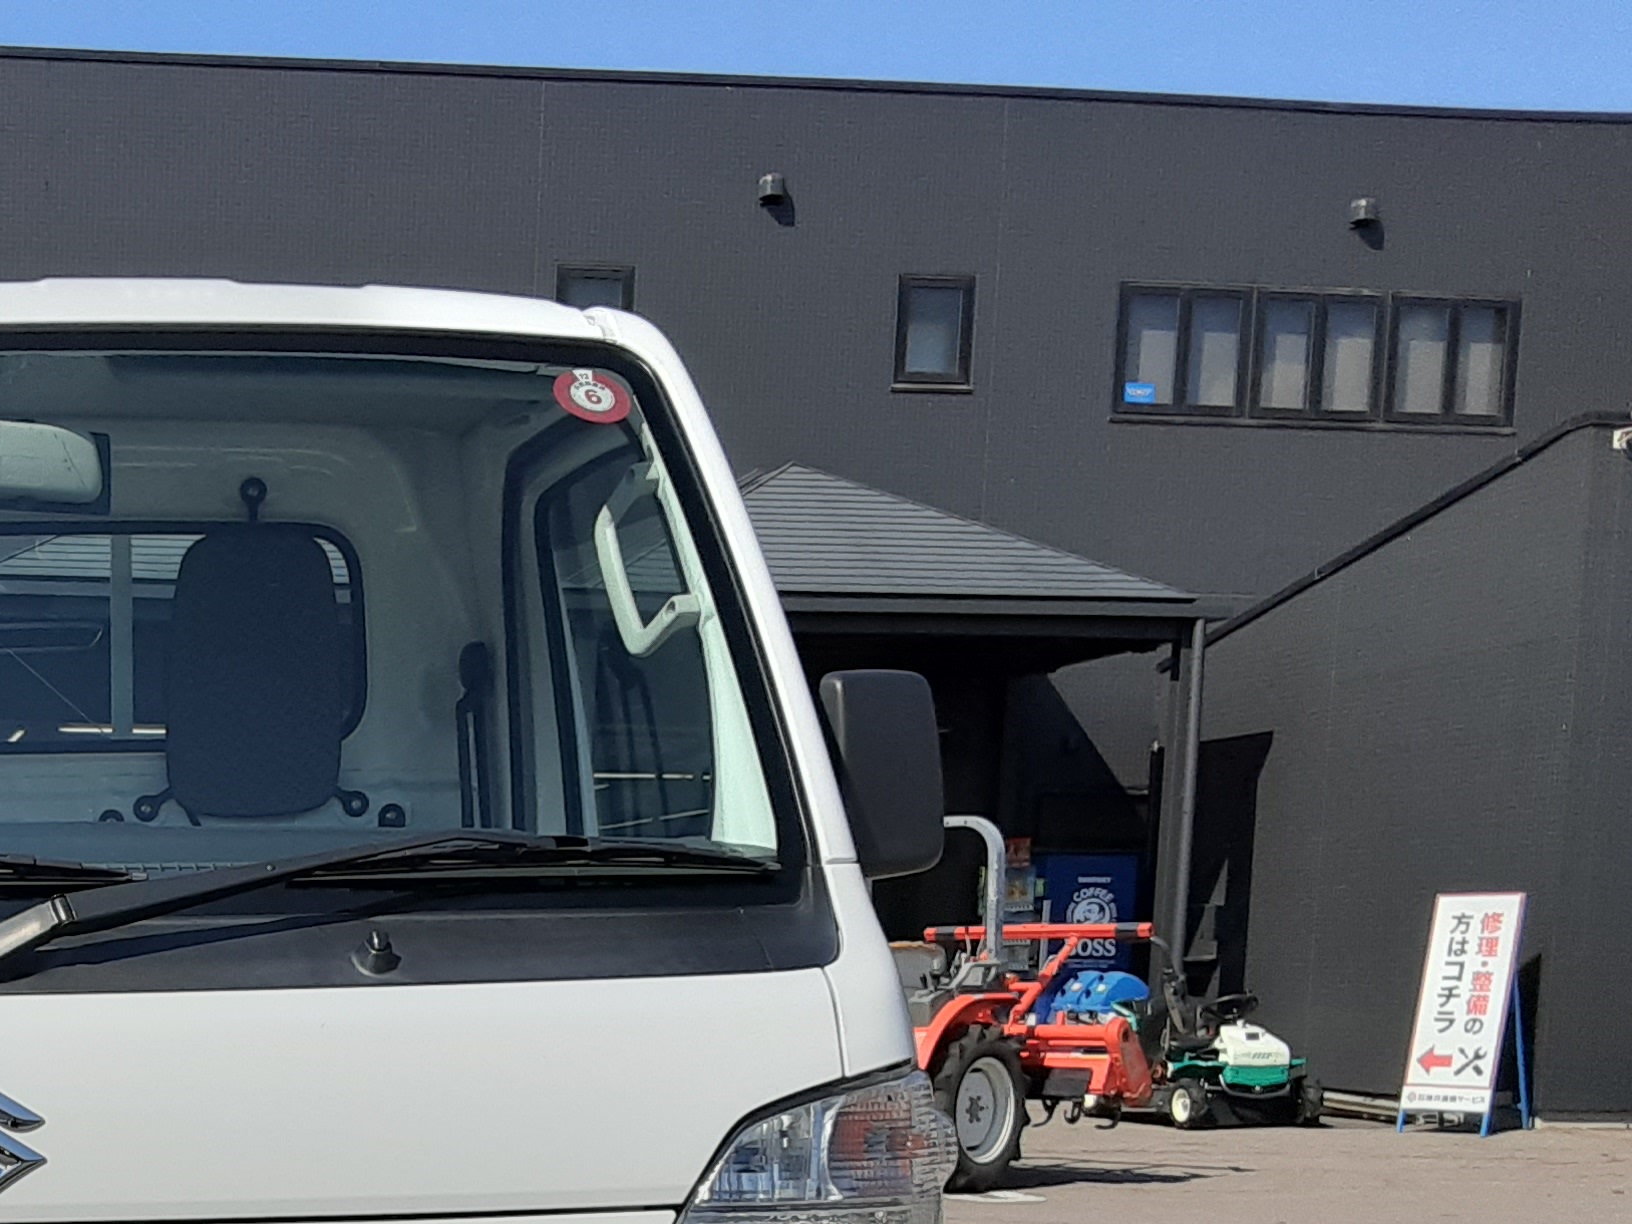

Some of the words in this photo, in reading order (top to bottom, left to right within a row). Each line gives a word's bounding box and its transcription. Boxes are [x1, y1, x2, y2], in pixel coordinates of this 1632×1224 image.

[584, 389, 603, 405] 6
[1433, 912, 1474, 1035] 方はコチラ
[1464, 912, 1504, 1035] 修理・整備の
